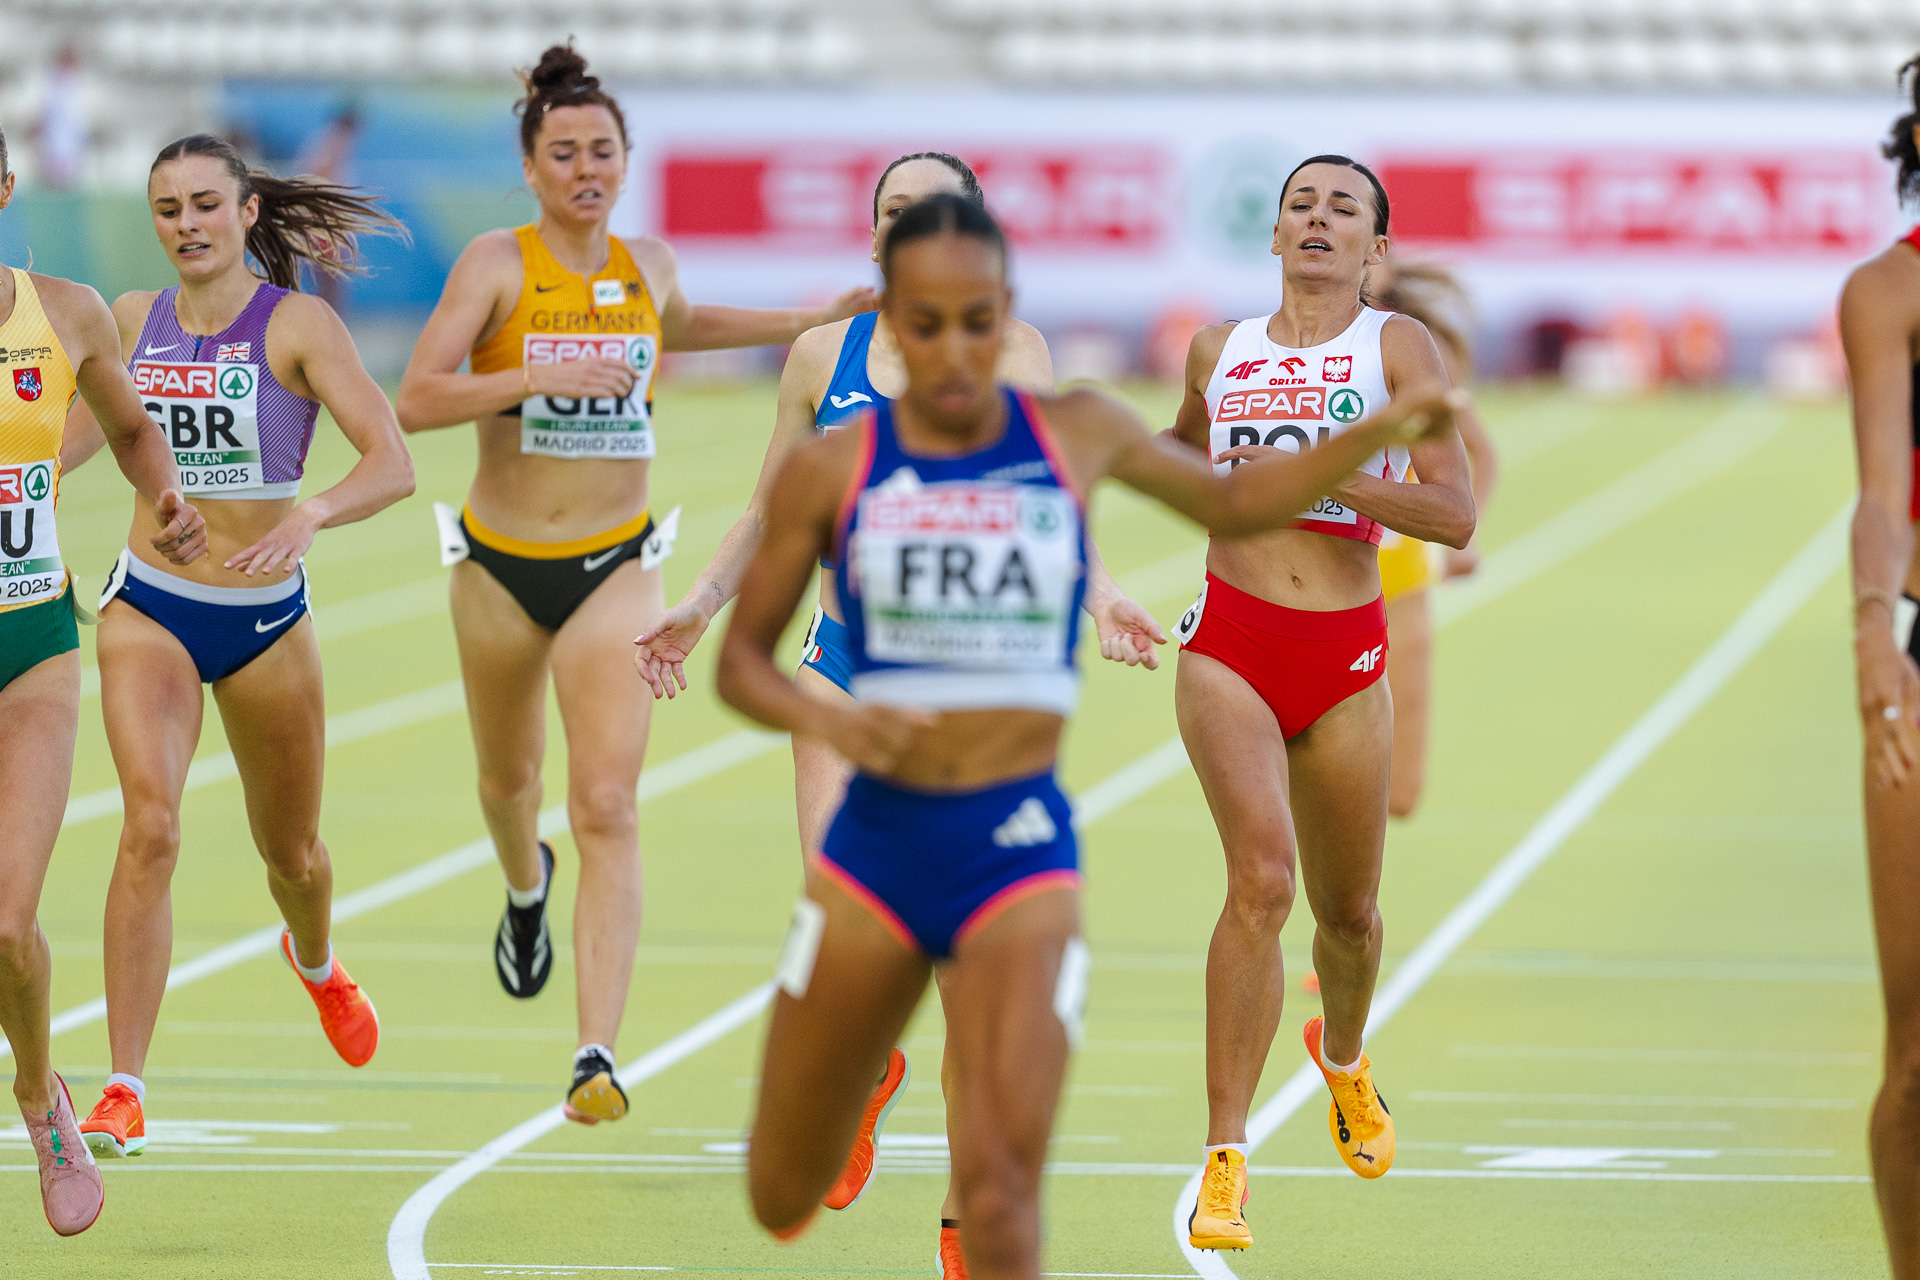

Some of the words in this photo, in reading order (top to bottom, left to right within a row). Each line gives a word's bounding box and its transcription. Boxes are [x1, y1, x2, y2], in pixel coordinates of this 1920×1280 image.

[764, 155, 1162, 243] SAR
[531, 309, 646, 331] GERMANY
[134, 367, 213, 394] SPAR
[1269, 378, 1306, 386] ORLEN
[1220, 392, 1322, 419] SPAR
[533, 435, 605, 452] MADRID
[610, 435, 647, 452] 2025
[204, 468, 249, 485] 2025
[1306, 499, 1343, 515] 025
[898, 543, 1037, 599] FRA
[7, 578, 52, 598] 2025
